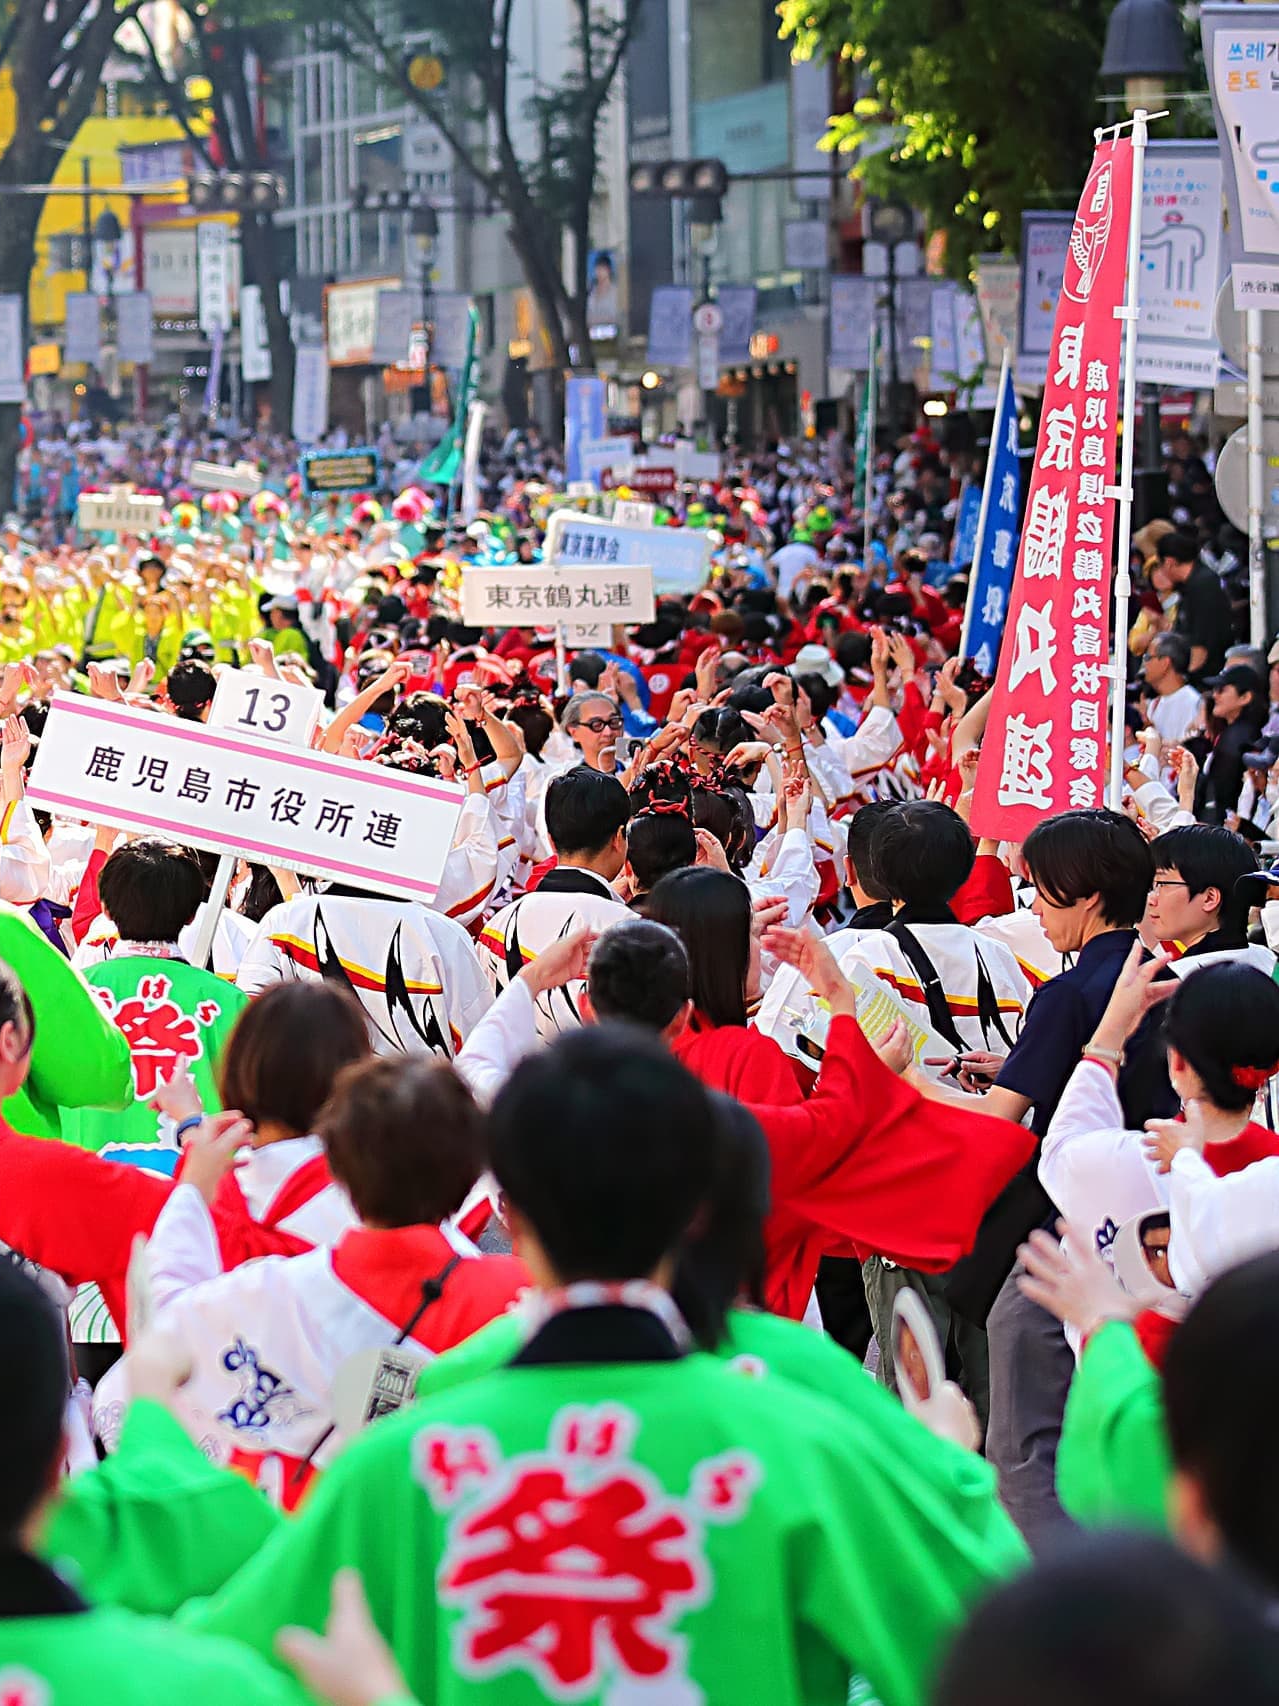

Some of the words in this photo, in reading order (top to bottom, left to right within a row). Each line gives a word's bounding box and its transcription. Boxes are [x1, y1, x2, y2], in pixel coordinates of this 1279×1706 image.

[485, 583, 632, 610] 東京鶴丸連
[576, 624, 599, 637] 52
[237, 687, 291, 732] 13
[85, 745, 403, 849] 鹿児島市役所連
[442, 1471, 696, 1686] 祭
